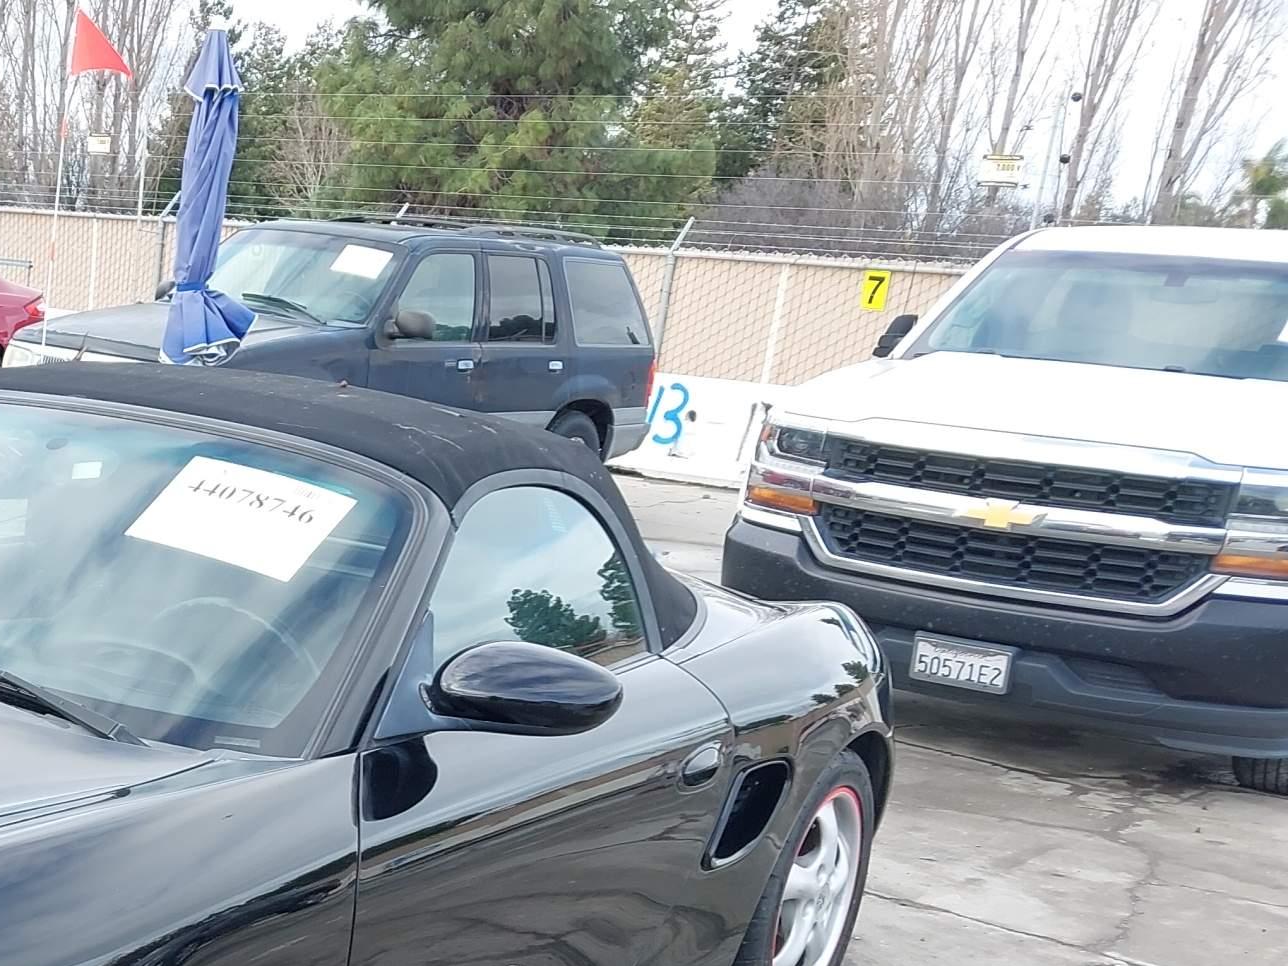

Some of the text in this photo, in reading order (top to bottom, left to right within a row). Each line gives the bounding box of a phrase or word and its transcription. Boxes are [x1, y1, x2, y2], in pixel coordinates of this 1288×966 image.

[868, 275, 885, 305] 7
[648, 382, 689, 445] 13
[187, 479, 315, 524] 44078746
[917, 653, 1002, 688] 50571E2
